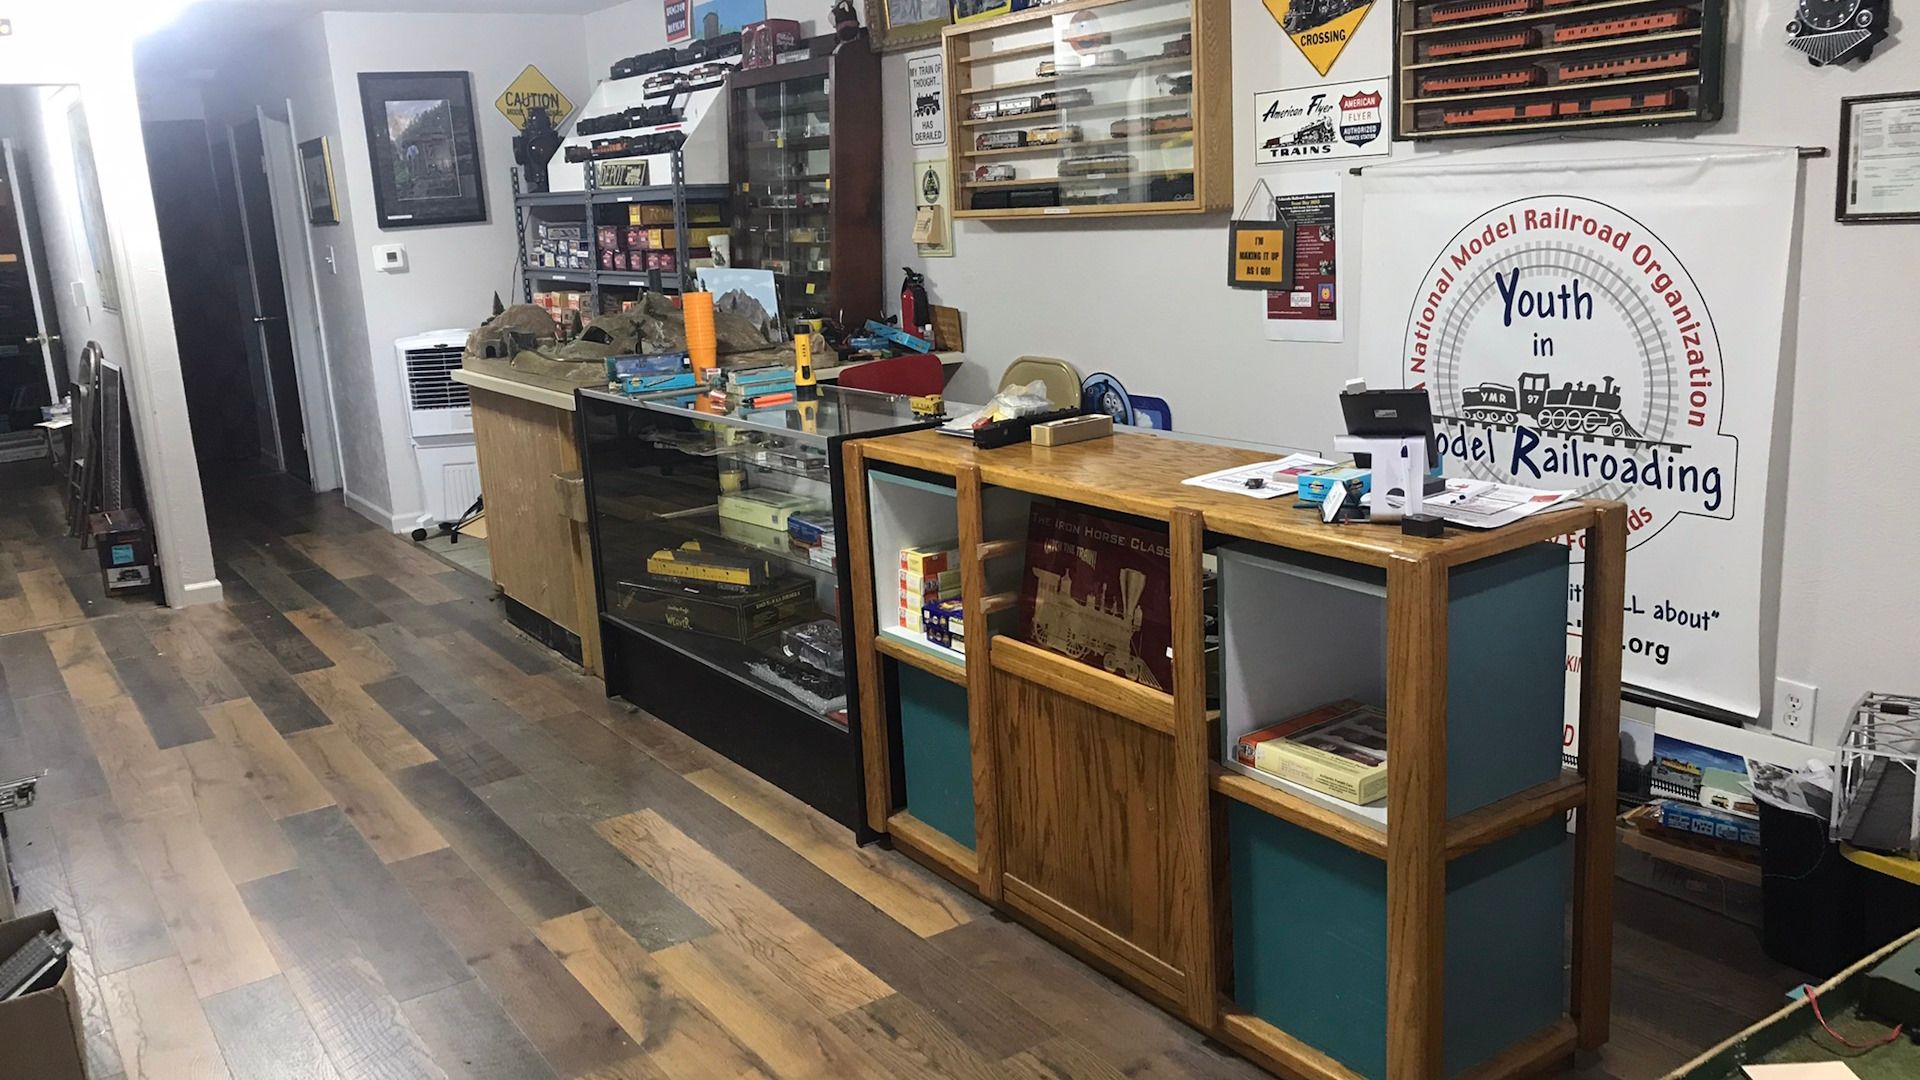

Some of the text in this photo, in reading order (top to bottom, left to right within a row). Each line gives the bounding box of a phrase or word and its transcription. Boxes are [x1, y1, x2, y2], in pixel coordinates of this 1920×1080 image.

[1300, 29, 1346, 47] CROSSING
[919, 65, 934, 76] TRAIN
[505, 91, 559, 108] CAUTION
[1343, 97, 1376, 109] AMERICAN
[1262, 93, 1334, 123] American Flyer
[1348, 111, 1372, 122] FLYER
[922, 120, 934, 130] HAS
[915, 130, 942, 142] DERAILED
[1270, 144, 1332, 158] TRAINS
[600, 165, 626, 187] DEPOT
[1239, 251, 1279, 261] MAKING IT UP
[1246, 266, 1254, 275] AS
[1495, 267, 1593, 327] Youth
[1410, 267, 1454, 373] National
[1450, 214, 1517, 271] Model
[1524, 207, 1632, 252] Railroad
[1632, 244, 1712, 427] Organization
[1533, 332, 1554, 357] in
[1480, 392, 1540, 404] YMR 97
[1436, 425, 1721, 511] odel Railroading
[1031, 512, 1050, 527] THE
[1055, 519, 1081, 536] IRON
[1084, 526, 1126, 546] HORSE
